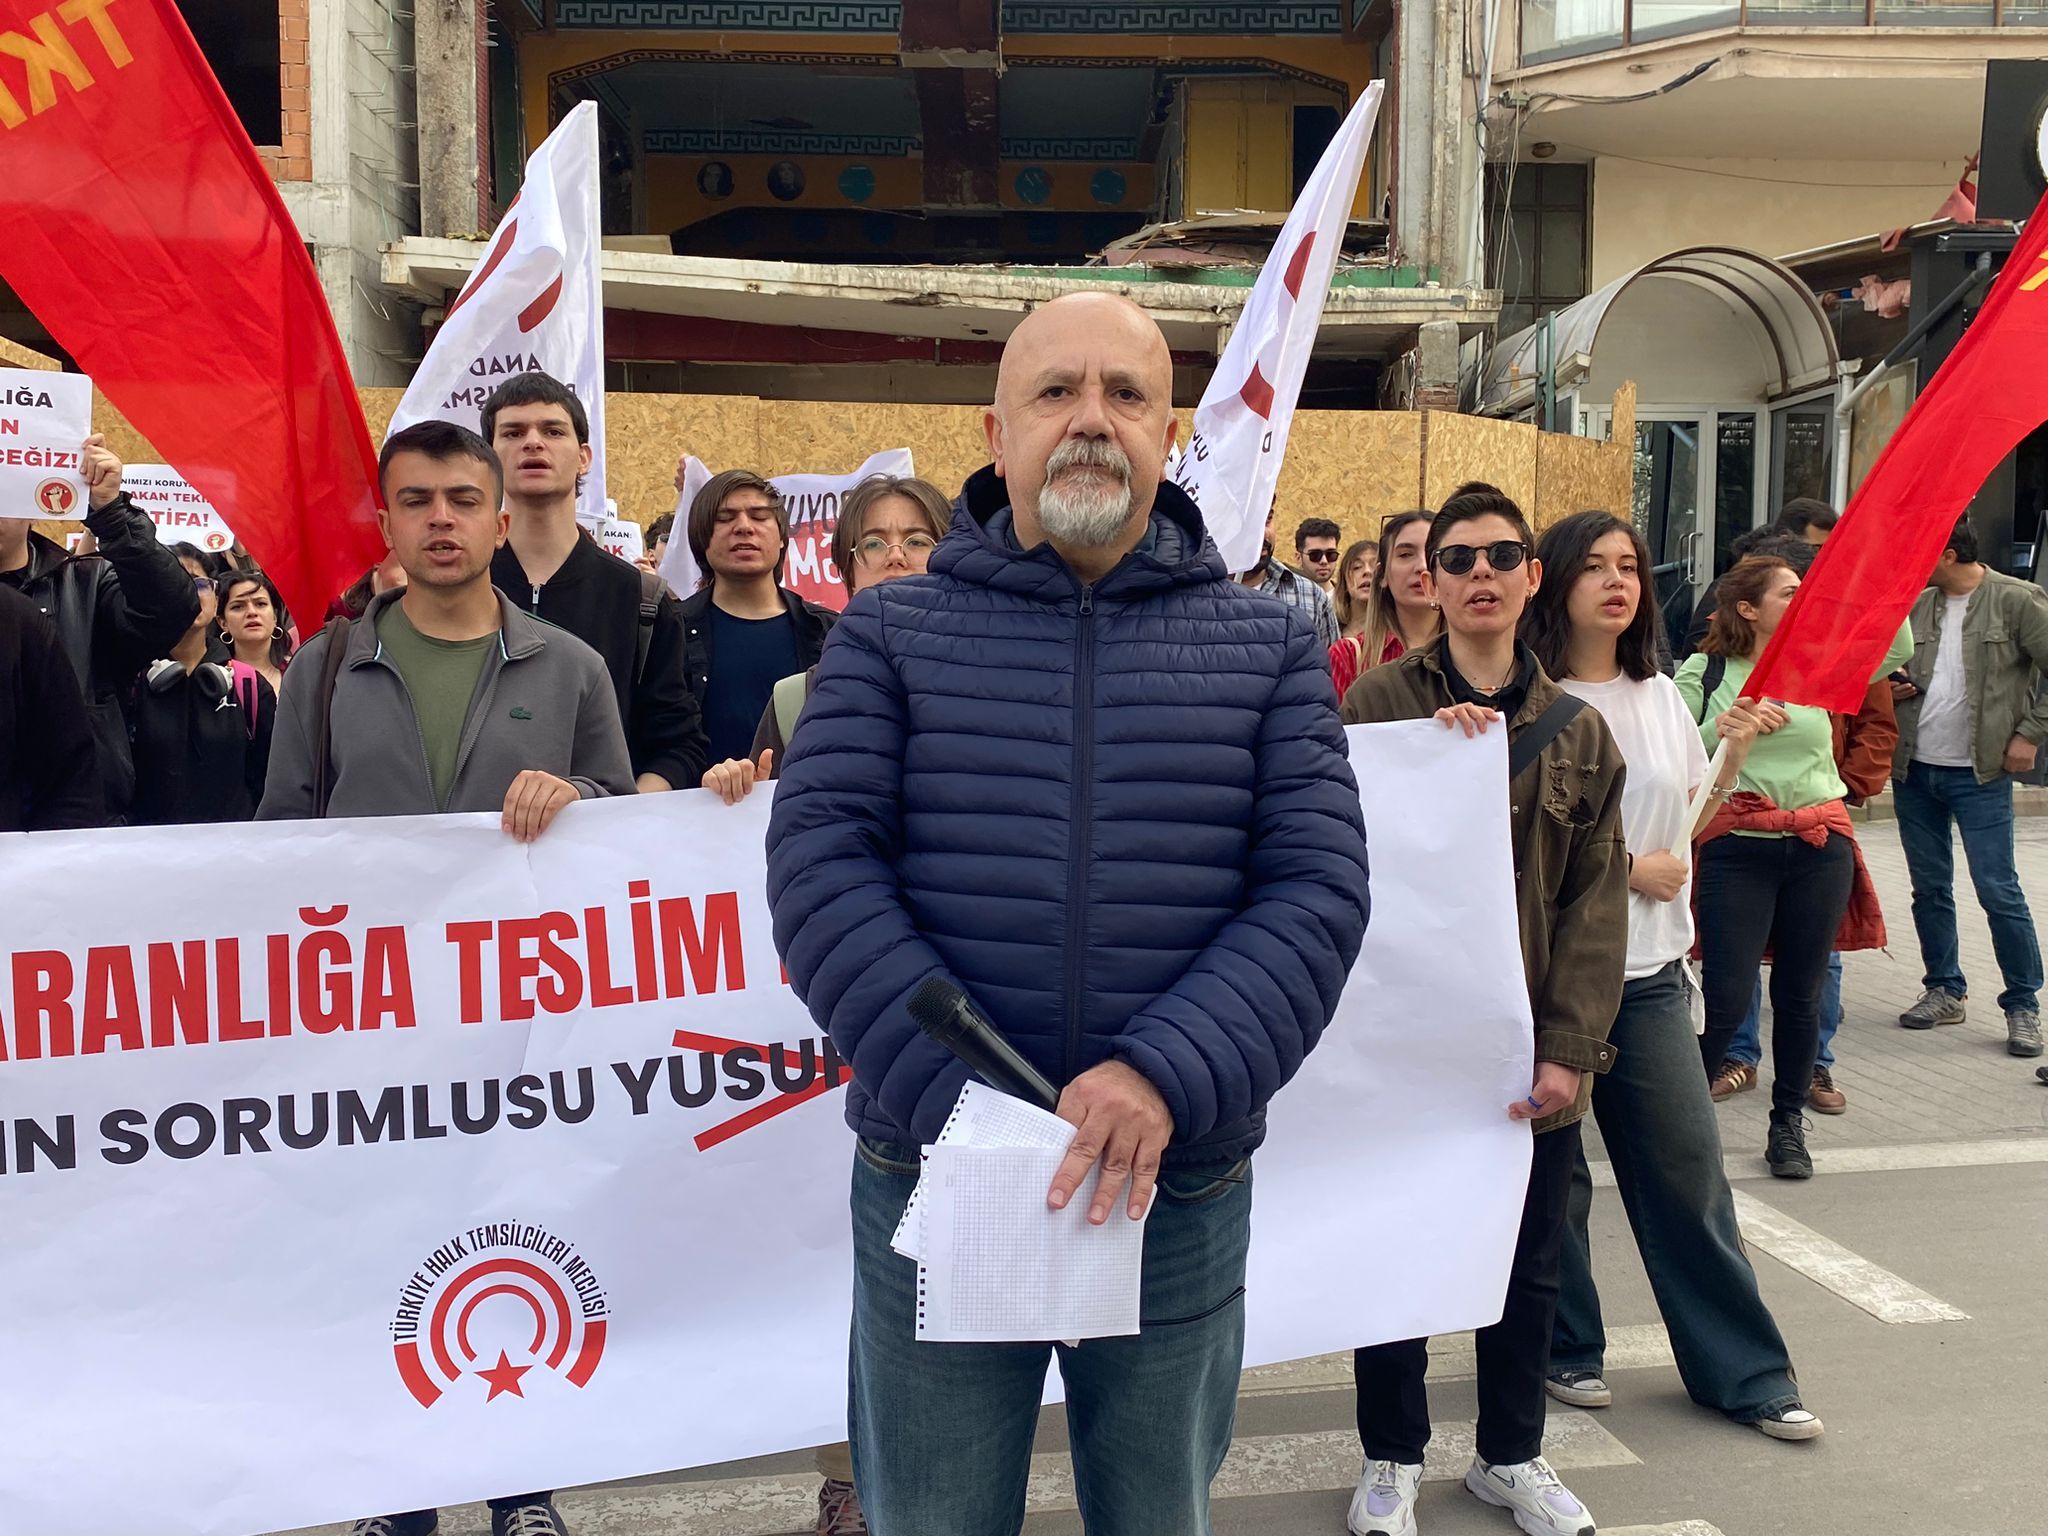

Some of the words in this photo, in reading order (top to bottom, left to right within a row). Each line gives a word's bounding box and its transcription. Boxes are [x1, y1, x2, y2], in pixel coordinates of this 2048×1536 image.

[0, 386, 53, 408] IĞA
[0, 446, 78, 469] EĞİZ!
[446, 880, 746, 1024] TESLİM
[99, 1066, 595, 1165] SORUMLUSU
[389, 1271, 435, 1341] TÜRKİYE
[423, 1236, 469, 1277] HALK
[466, 1219, 575, 1265] TEMSİLCİLERİ
[562, 1255, 612, 1318] MECLİSİ
